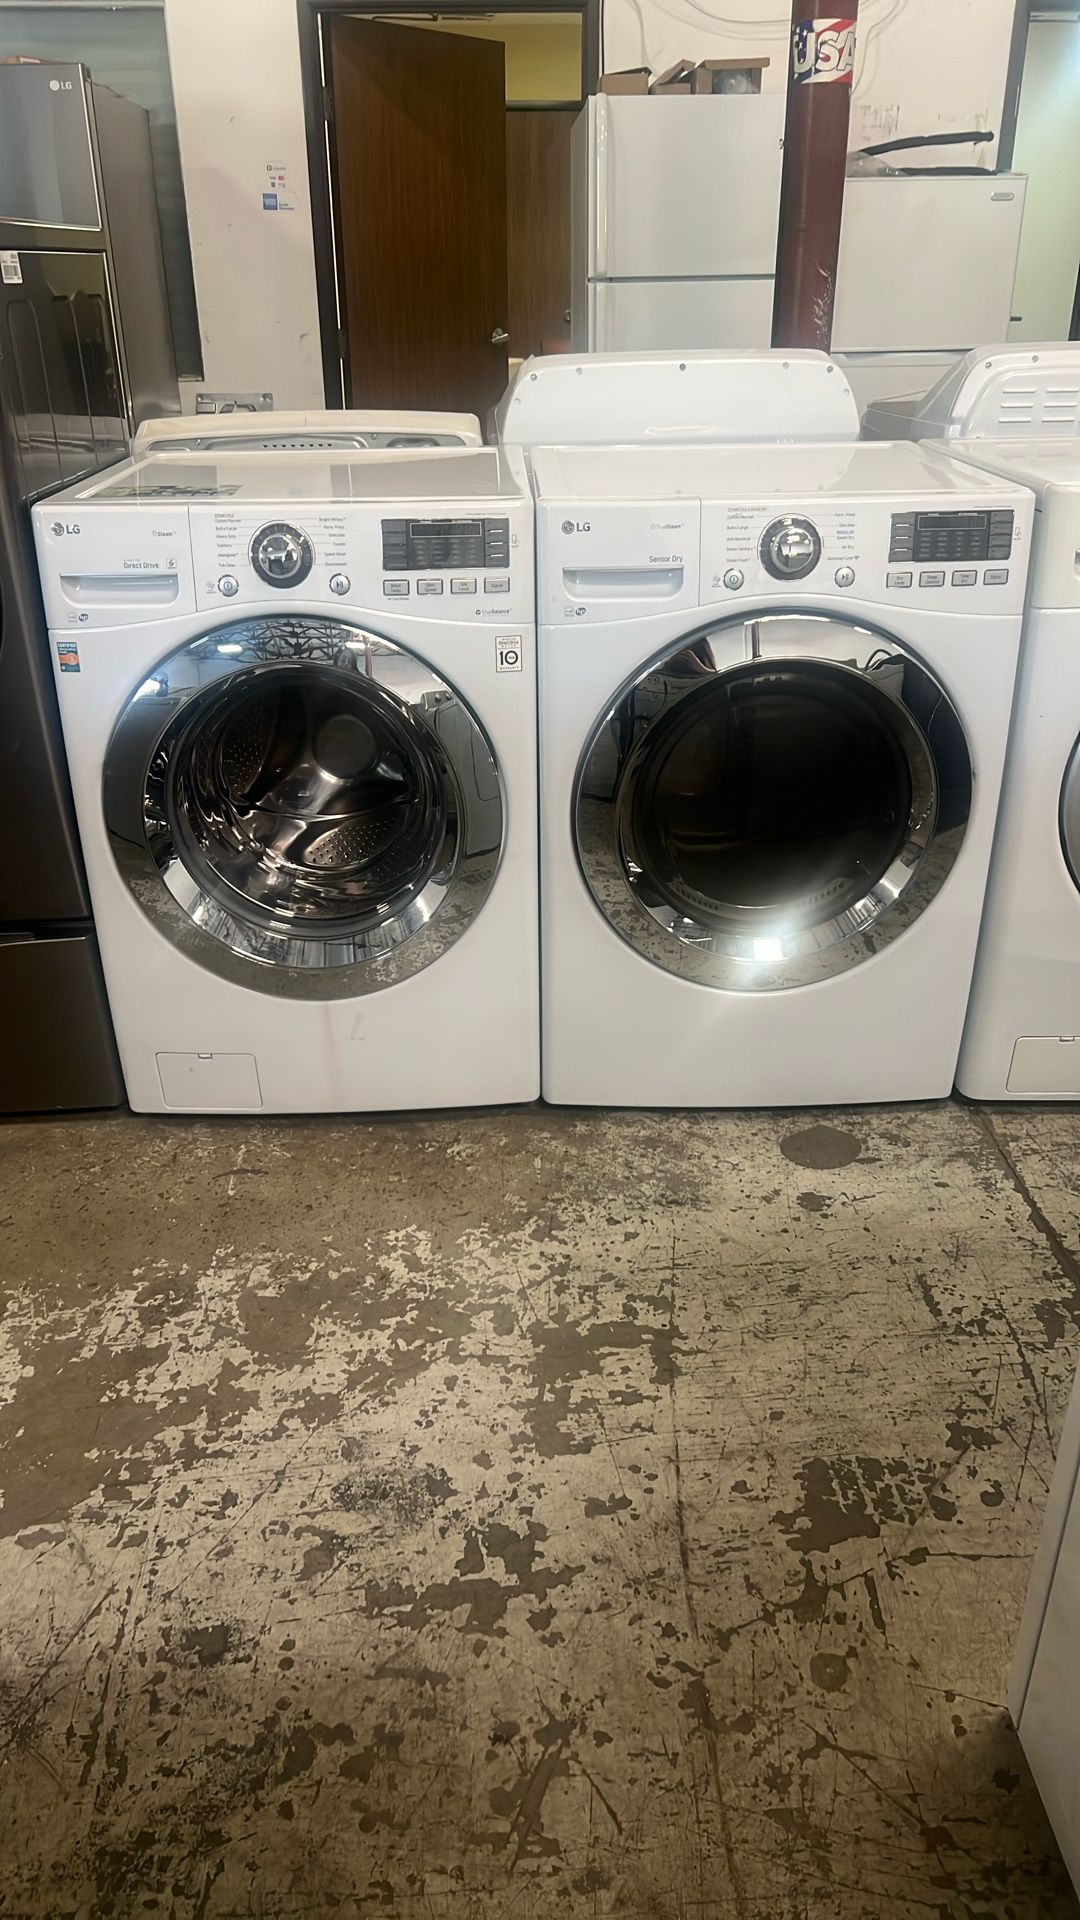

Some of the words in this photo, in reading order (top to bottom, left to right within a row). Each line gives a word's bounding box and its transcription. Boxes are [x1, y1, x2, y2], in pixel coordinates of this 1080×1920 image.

[793, 31, 857, 74] USA
[60, 81, 72, 90] LG
[66, 524, 81, 535] LG
[576, 522, 591, 532] LG
[649, 555, 671, 563] Sensor
[672, 555, 684, 563] Dry
[499, 650, 519, 665] 10
